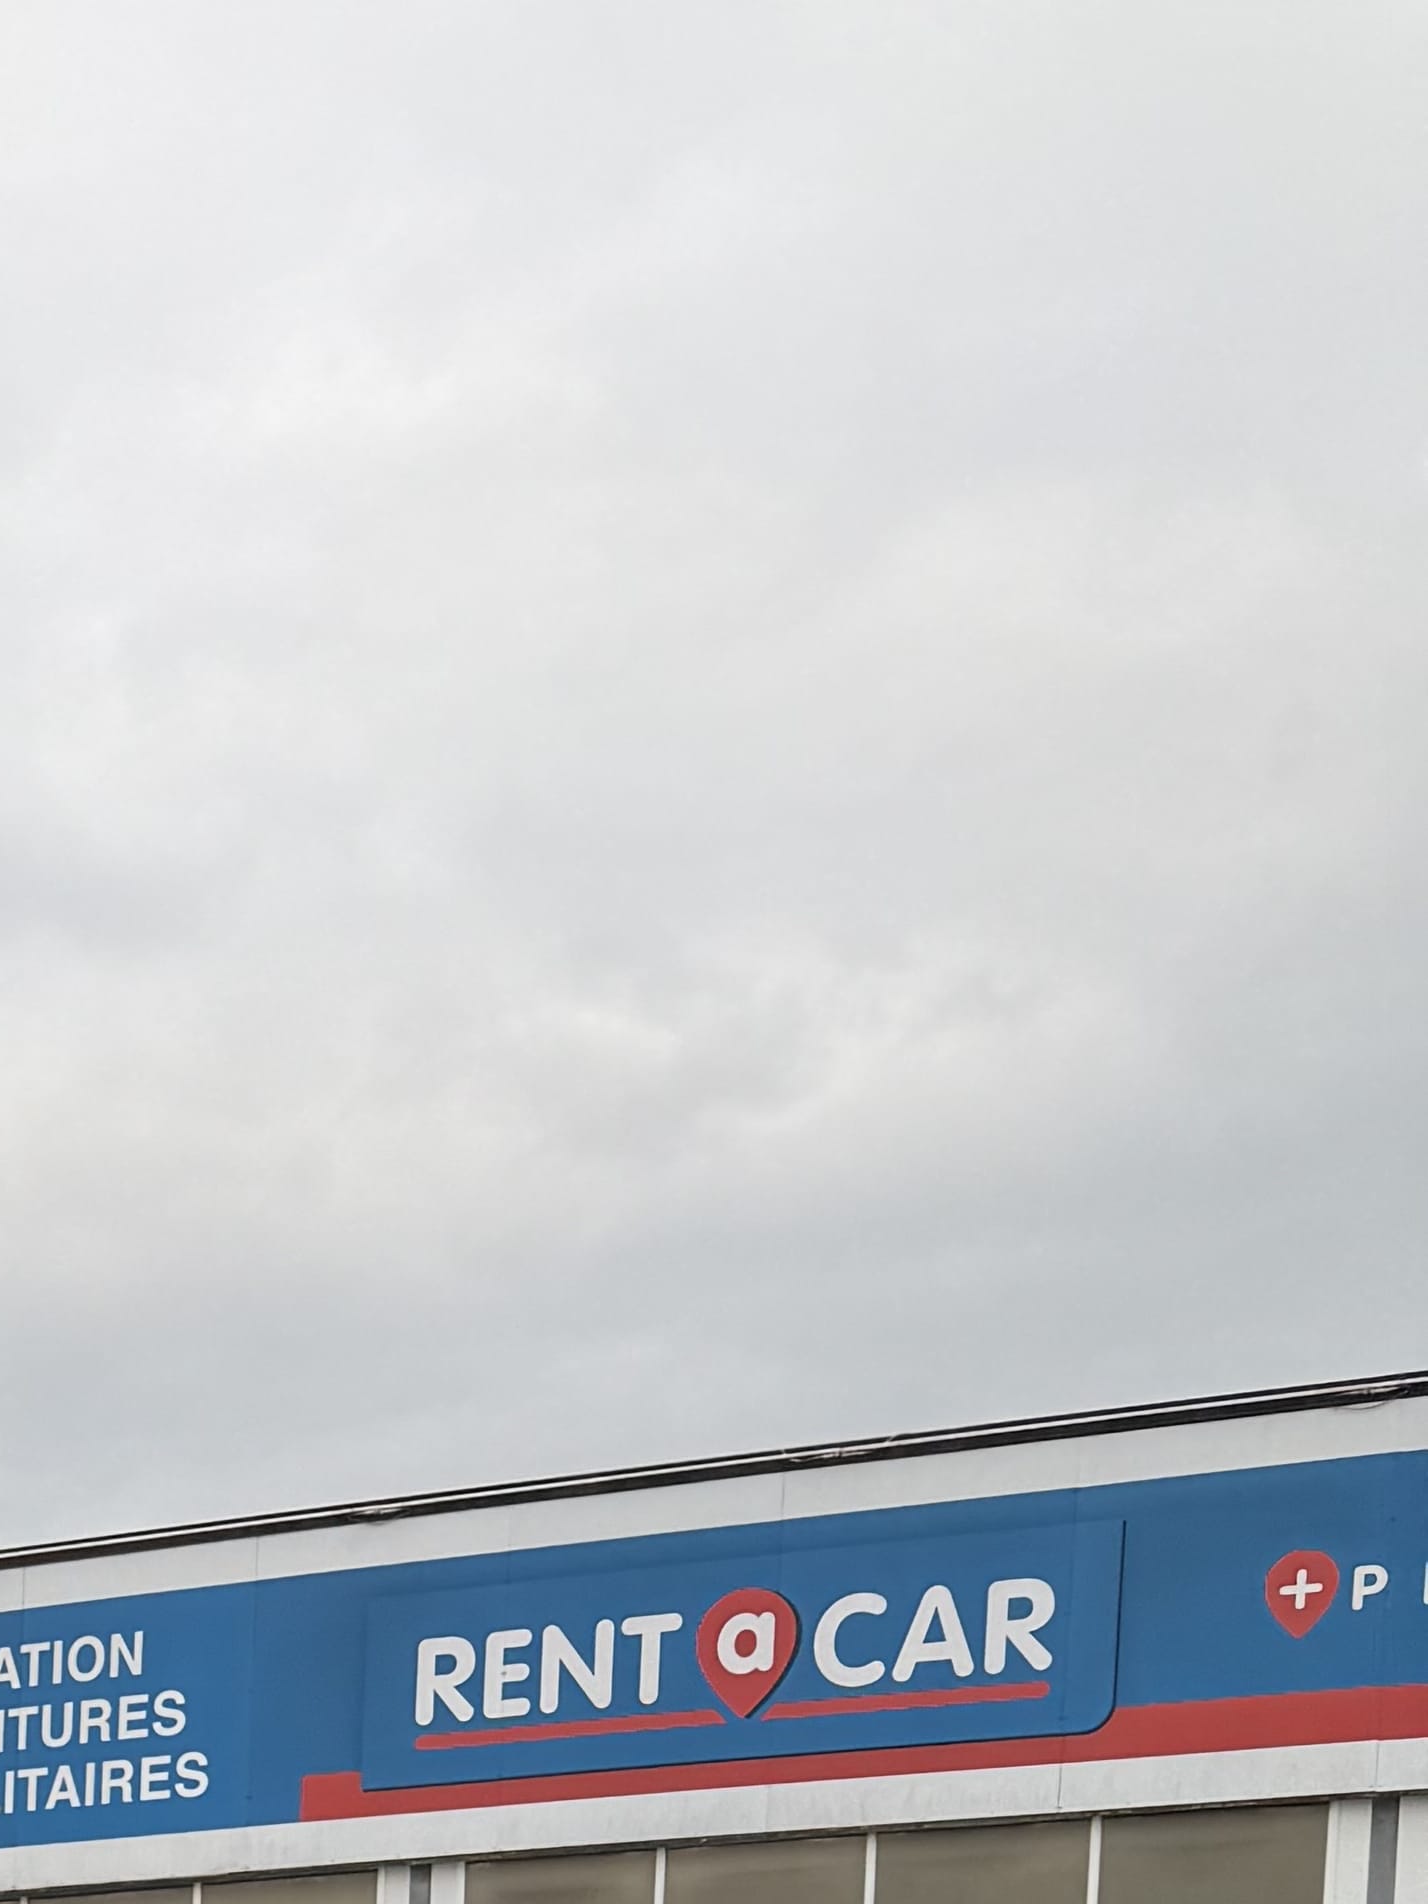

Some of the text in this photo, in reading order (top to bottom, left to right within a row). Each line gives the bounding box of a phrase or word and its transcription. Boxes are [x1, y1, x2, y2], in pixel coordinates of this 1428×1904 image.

[414, 1577, 1056, 1727] RENT a CAR
